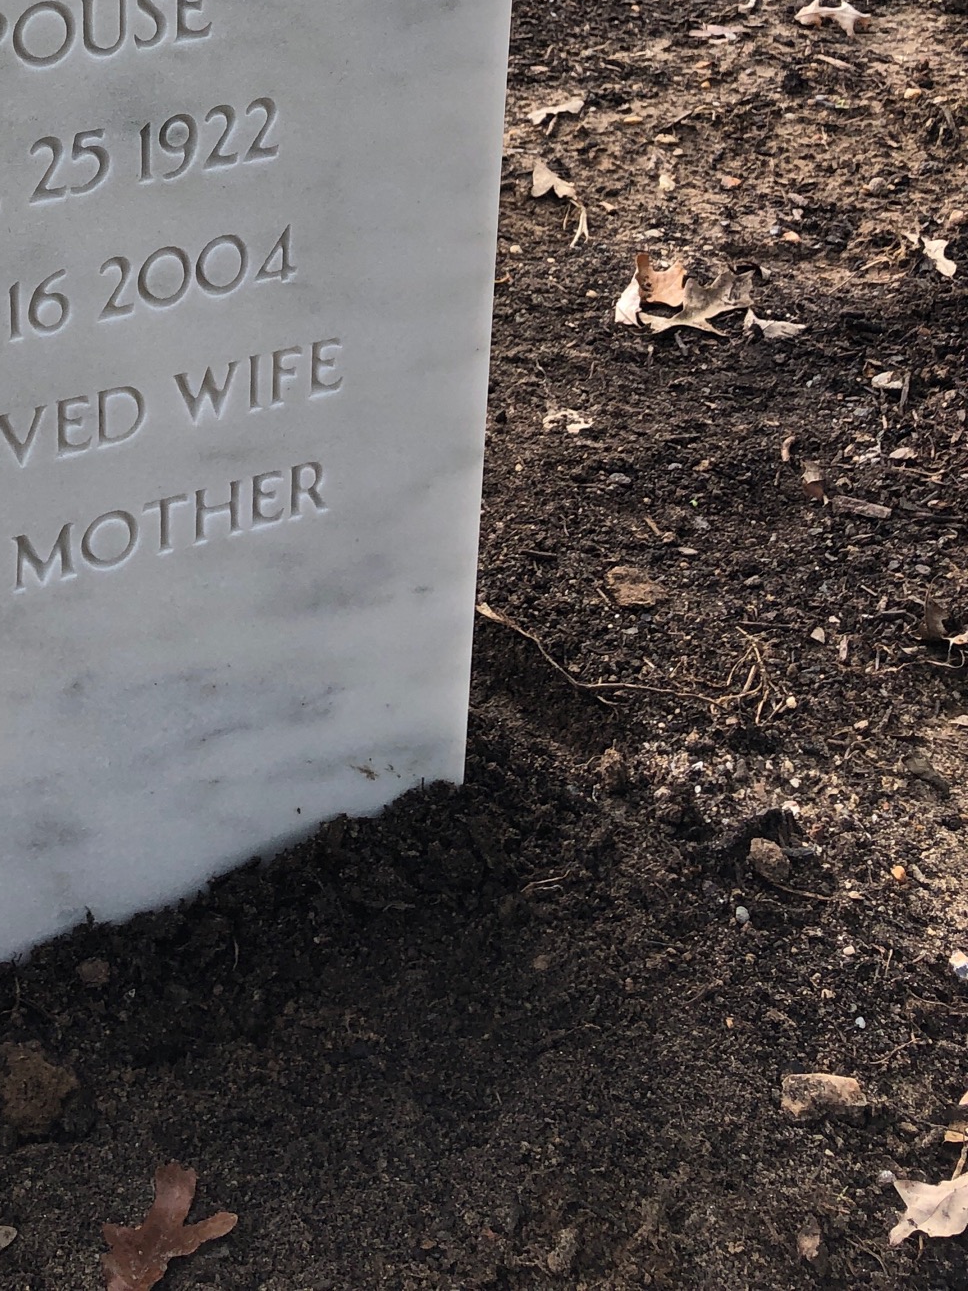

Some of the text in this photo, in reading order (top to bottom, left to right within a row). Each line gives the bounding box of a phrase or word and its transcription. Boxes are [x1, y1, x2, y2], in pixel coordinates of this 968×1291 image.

[28, 127, 111, 207] 25
[137, 96, 281, 185] 1922
[8, 267, 73, 344] 16
[96, 223, 299, 325] 2004
[172, 336, 345, 426] WIFE
[11, 460, 331, 595] MOTHER
